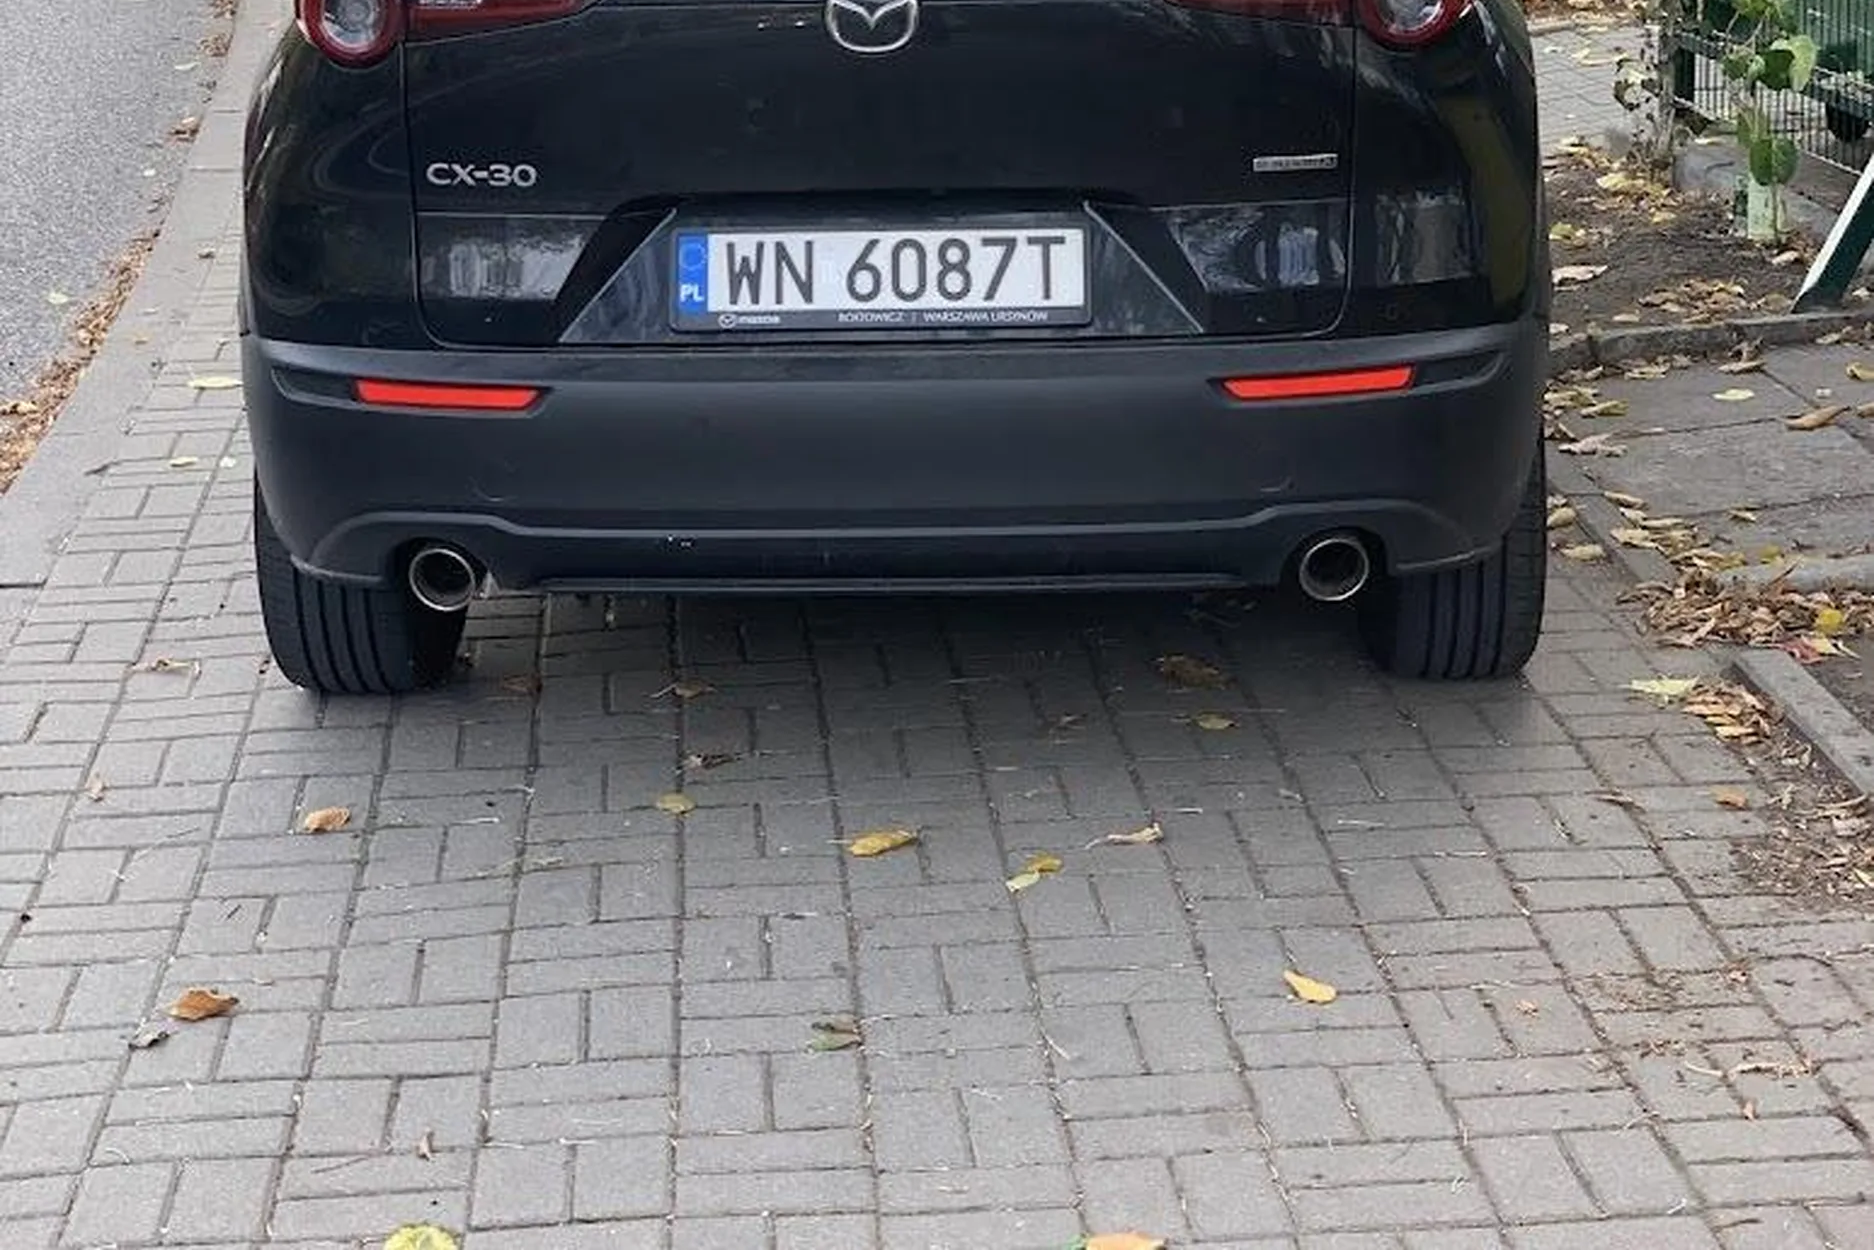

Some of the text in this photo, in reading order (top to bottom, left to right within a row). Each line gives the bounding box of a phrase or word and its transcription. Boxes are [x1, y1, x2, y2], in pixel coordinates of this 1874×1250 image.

[426, 162, 537, 187] CX-30
[726, 236, 1067, 305] WN 6087T
[680, 283, 704, 301] PL
[923, 311, 989, 322] WARSZAWA
